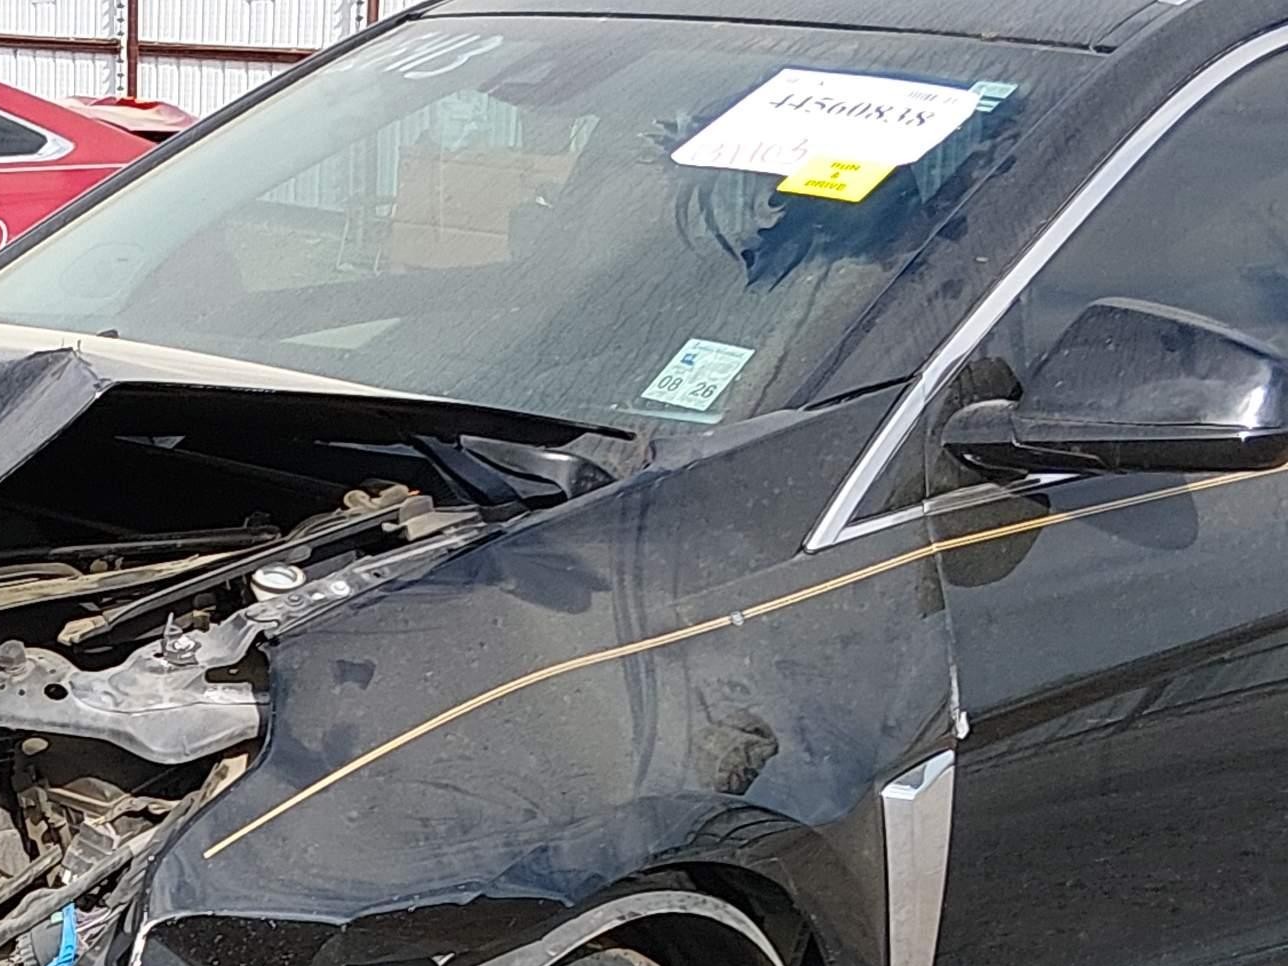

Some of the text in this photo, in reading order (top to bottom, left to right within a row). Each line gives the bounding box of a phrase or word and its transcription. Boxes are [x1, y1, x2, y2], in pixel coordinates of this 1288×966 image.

[768, 93, 936, 127] 44560838
[830, 162, 861, 171] RUN
[804, 179, 847, 191] DRIVE
[657, 375, 718, 398] 08 26
